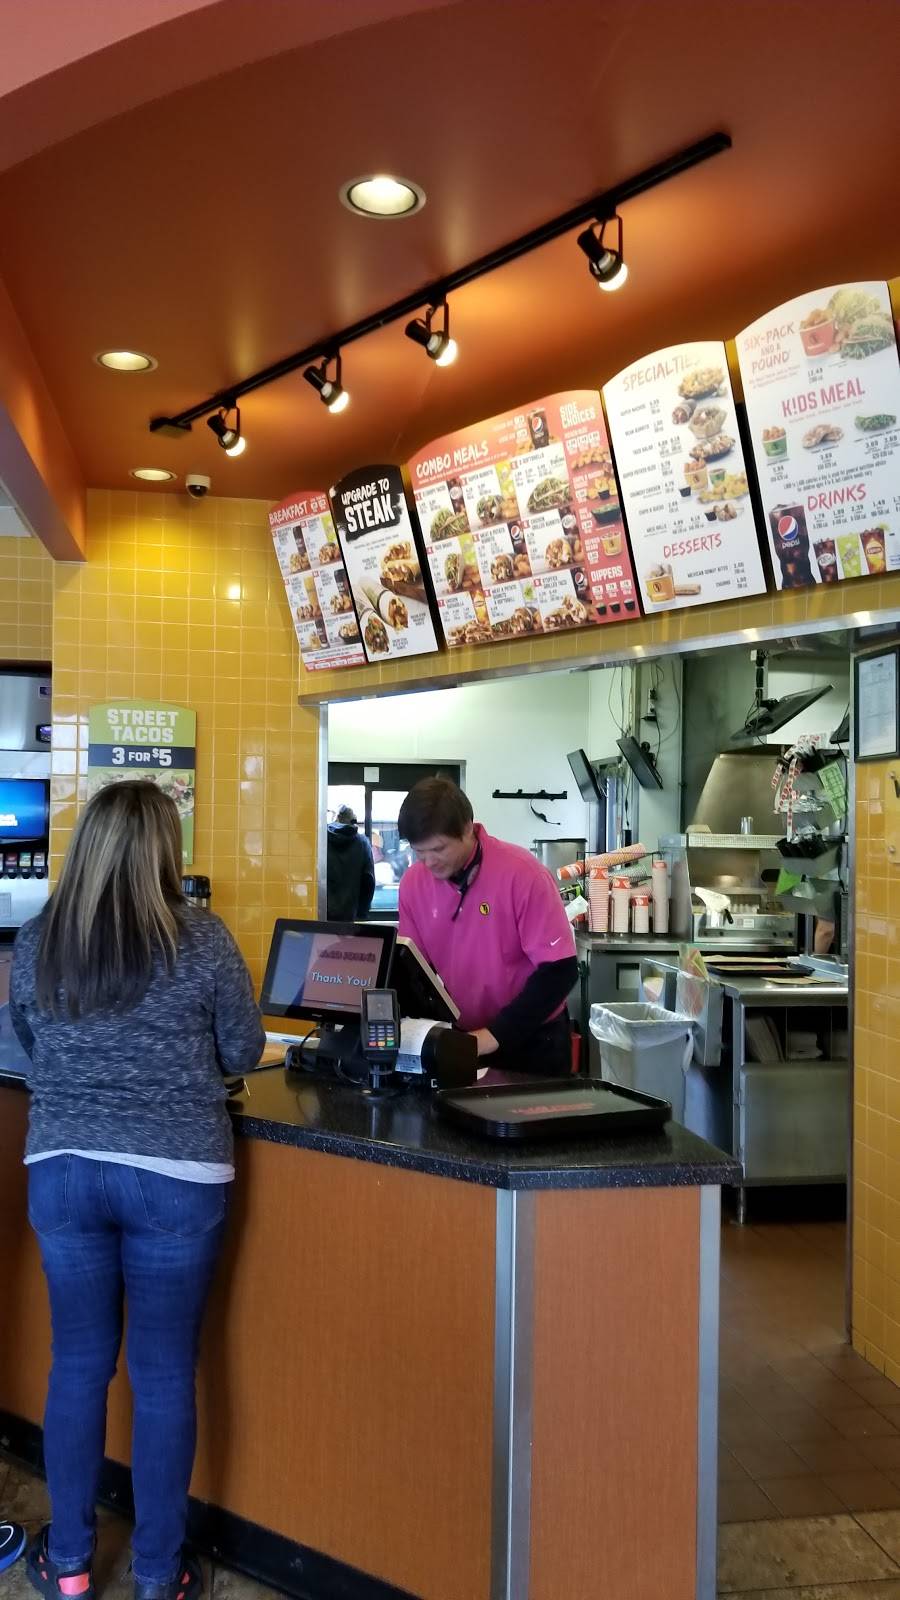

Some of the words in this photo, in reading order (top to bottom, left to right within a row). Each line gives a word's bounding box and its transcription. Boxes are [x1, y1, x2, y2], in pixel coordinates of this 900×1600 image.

[744, 321, 794, 351] SIX-PACK
[752, 350, 790, 376] POUND
[820, 378, 865, 406] MEAL
[416, 454, 452, 478] COMBO
[453, 440, 488, 467] MEALS
[341, 486, 377, 505] UPGRADE
[377, 478, 390, 497] TO
[807, 483, 867, 512] DRINKS
[268, 502, 308, 524] BREAKFAST
[345, 494, 395, 532] STEAK
[663, 533, 722, 558] DESSERTS
[591, 566, 623, 582] DIPPERS
[107, 709, 178, 726] STREET
[110, 726, 174, 743] TACOS
[112, 747, 125, 764] 3
[128, 752, 150, 762] FOR
[152, 748, 172, 766] $5
[312, 972, 342, 984] Thank
[347, 975, 372, 986] You!
